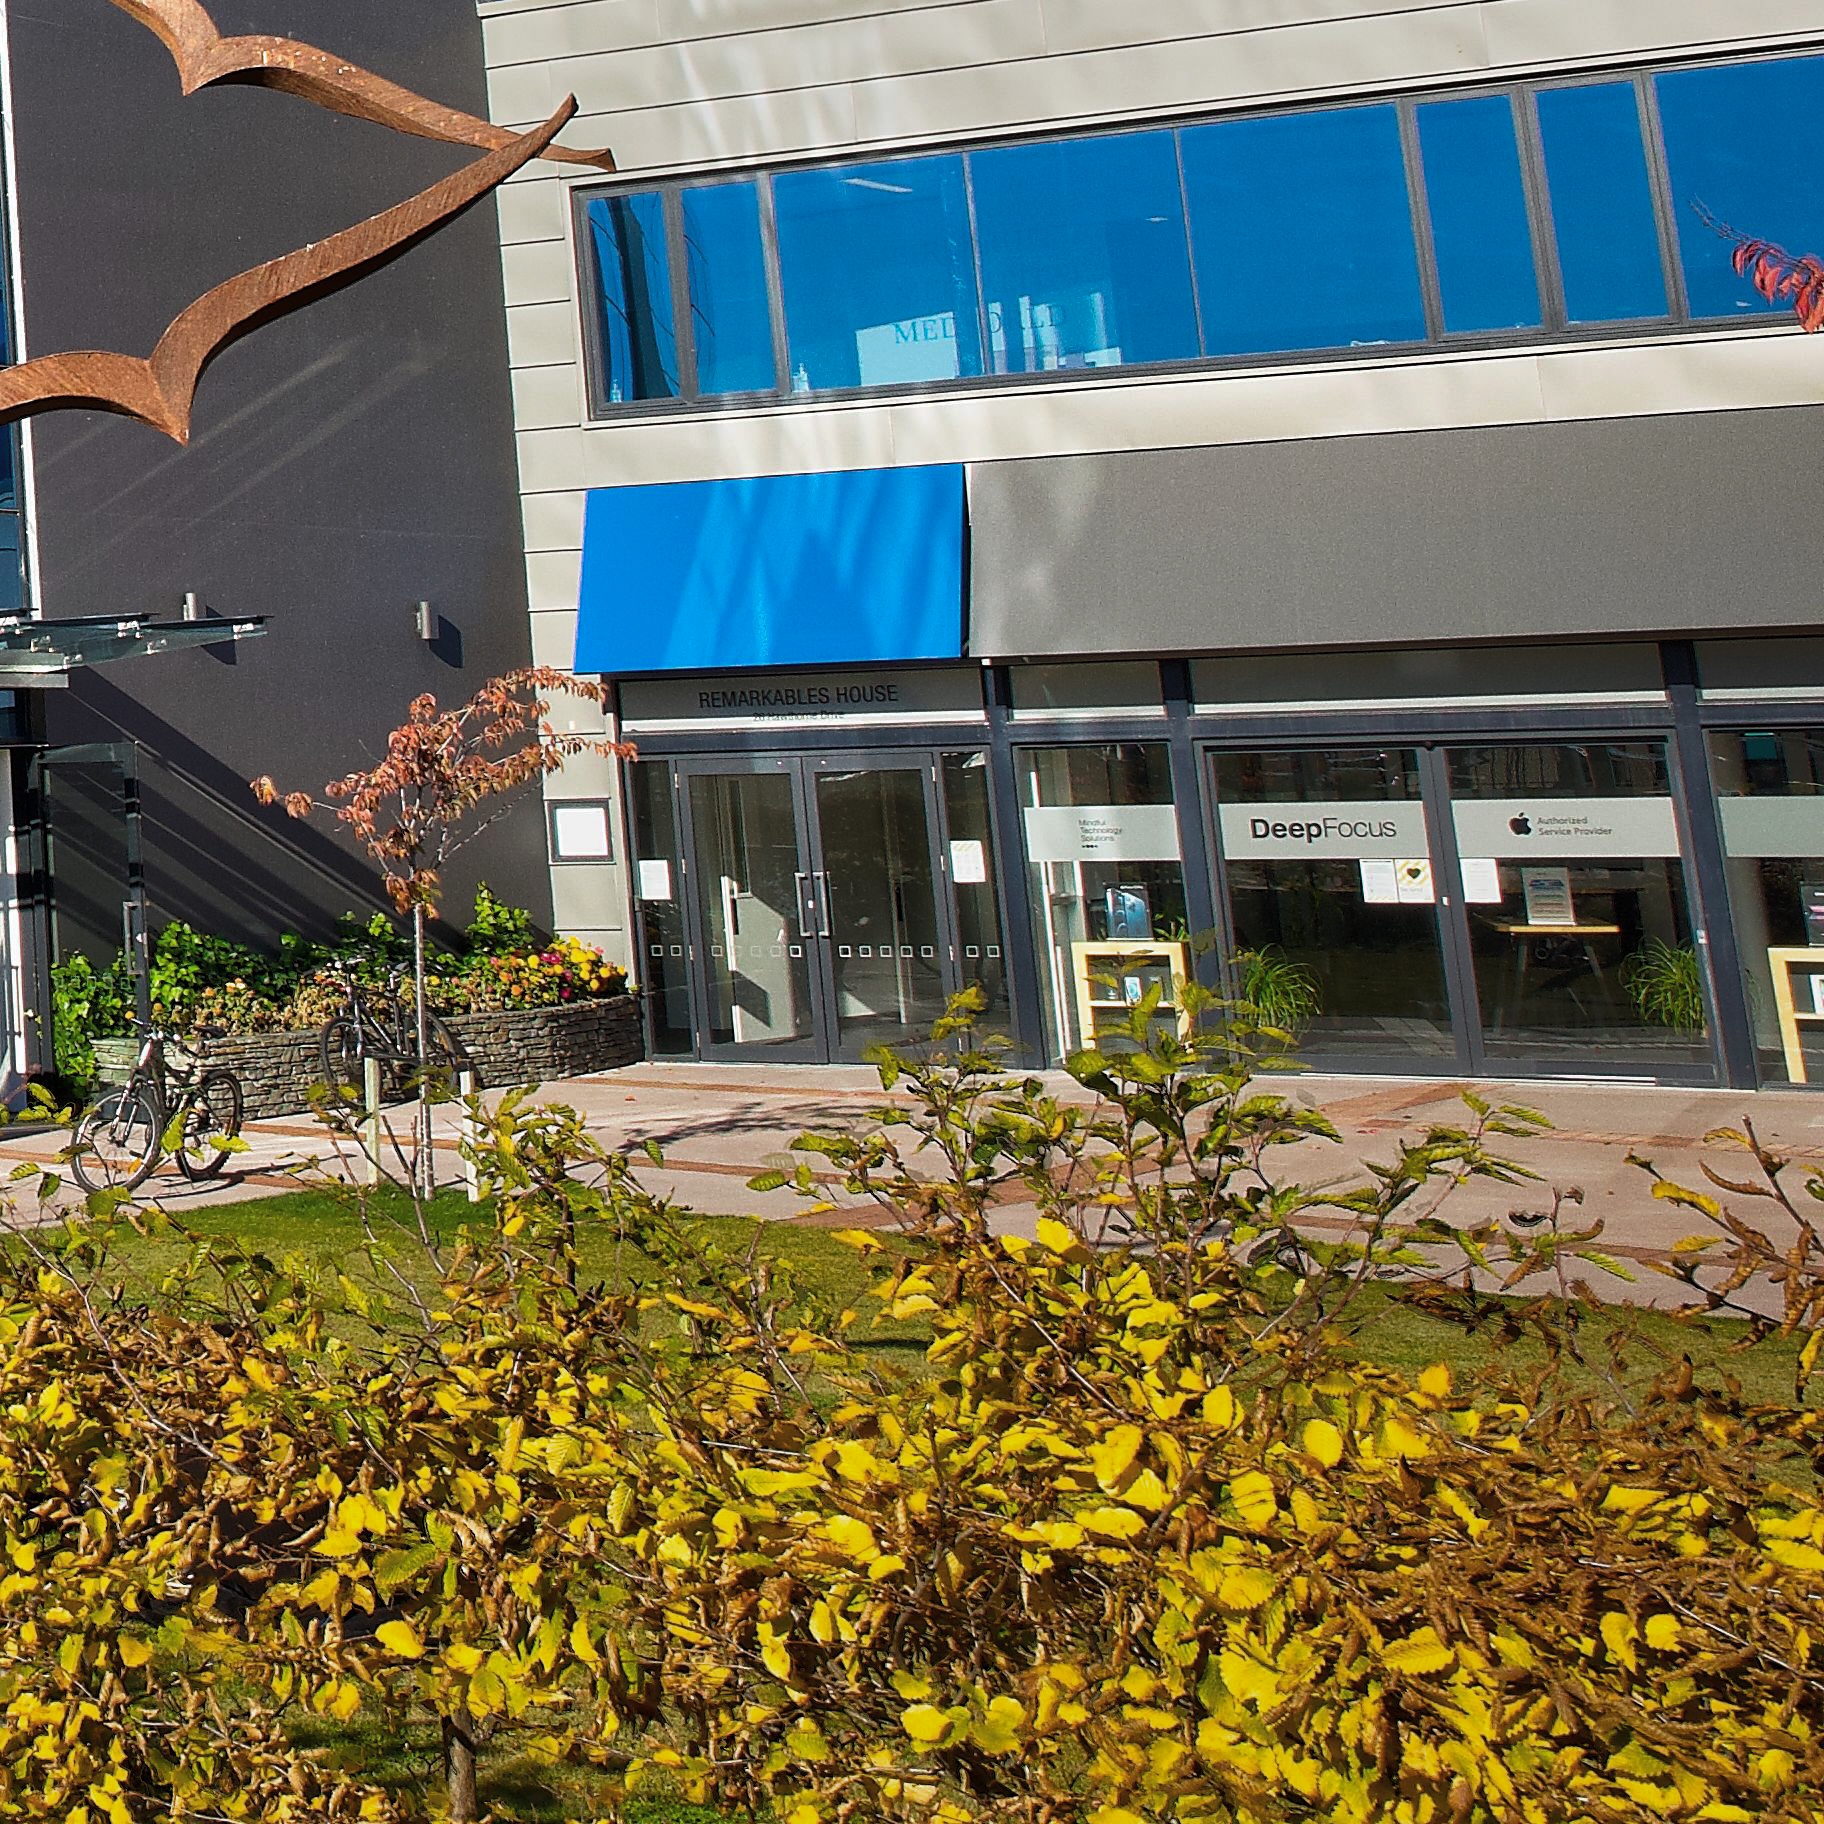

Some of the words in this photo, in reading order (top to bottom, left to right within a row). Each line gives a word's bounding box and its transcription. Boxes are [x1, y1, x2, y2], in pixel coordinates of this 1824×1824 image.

[699, 687, 829, 708] REMARKABLES
[837, 684, 899, 704] HOUSE
[1250, 817, 1398, 844] DeepFocus
[1538, 828, 1572, 836] Service
[1574, 827, 1612, 835] Provider
